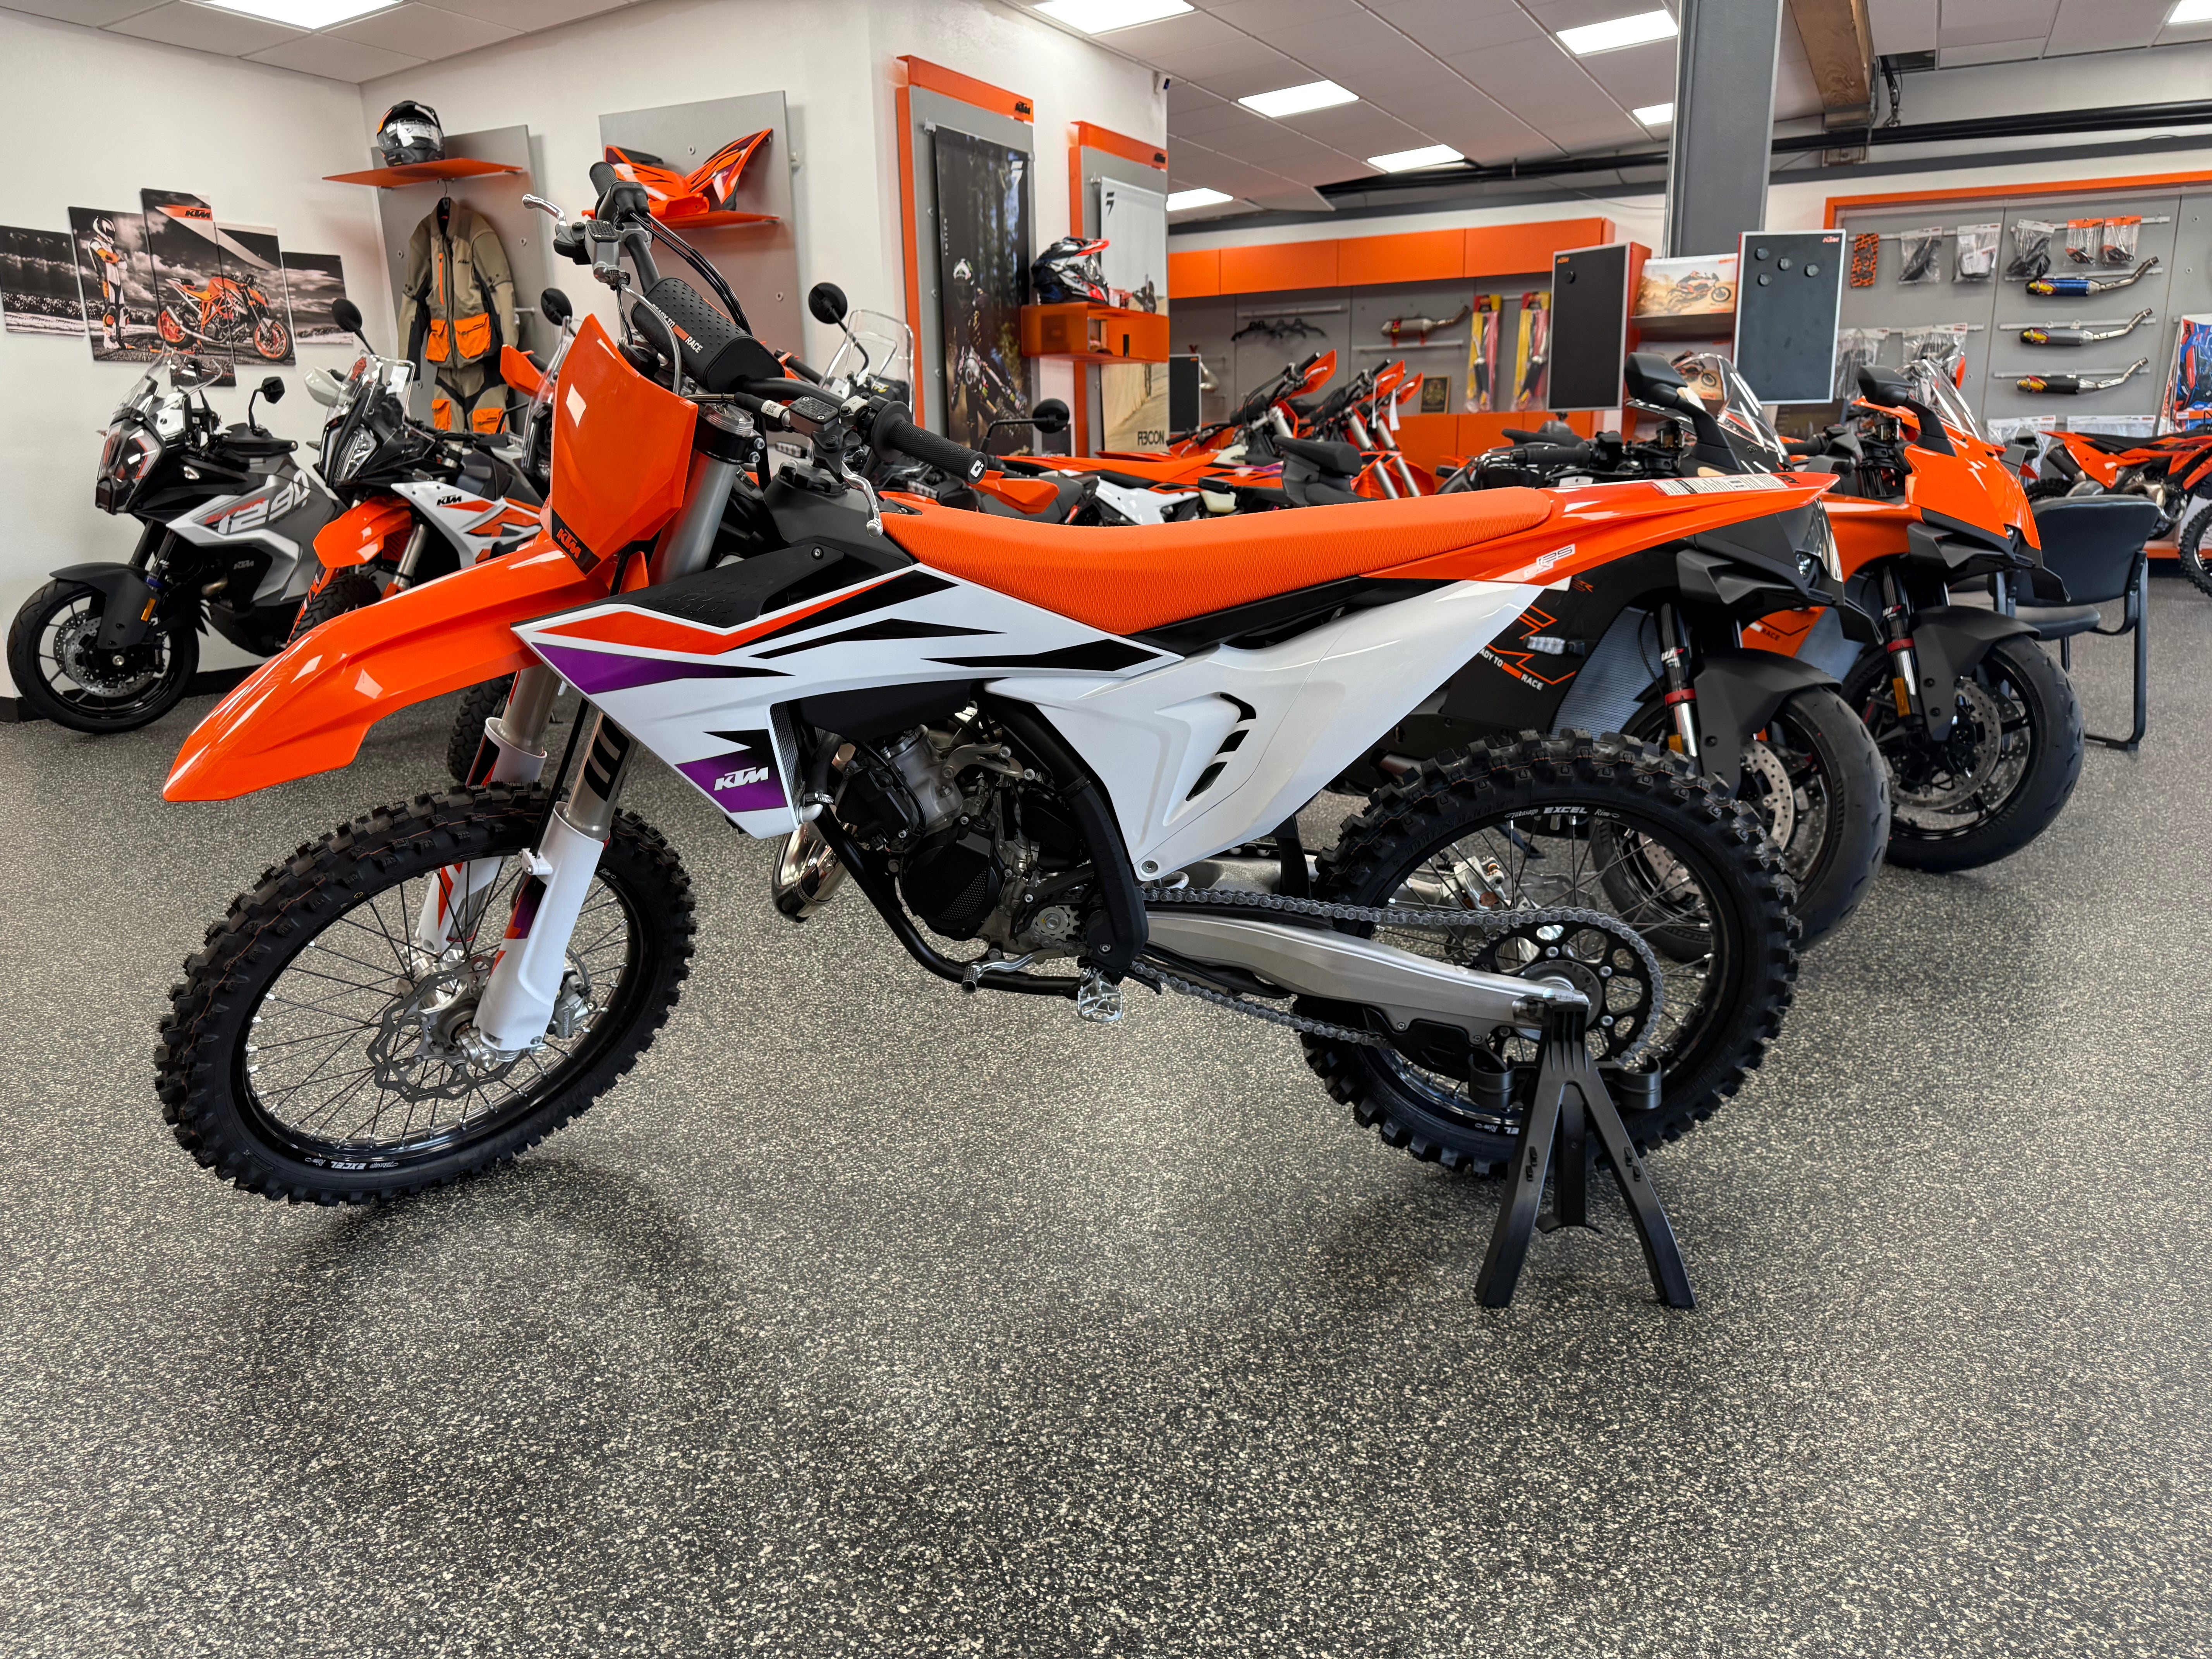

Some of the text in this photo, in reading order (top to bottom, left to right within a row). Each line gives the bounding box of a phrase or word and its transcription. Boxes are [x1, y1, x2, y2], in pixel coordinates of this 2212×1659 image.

[1015, 101, 1030, 115] KTM
[185, 209, 211, 218] KTM
[685, 336, 703, 353] RACE
[217, 469, 311, 534] 1290
[436, 495, 462, 506] KTM
[556, 528, 581, 559] KTM
[1539, 546, 1573, 566] 125
[234, 560, 254, 570] KTM
[1761, 627, 1780, 641] RACE
[1479, 648, 1544, 691] ADY TO RACE
[714, 767, 769, 791] KTM
[331, 1161, 367, 1170] EXCEL
